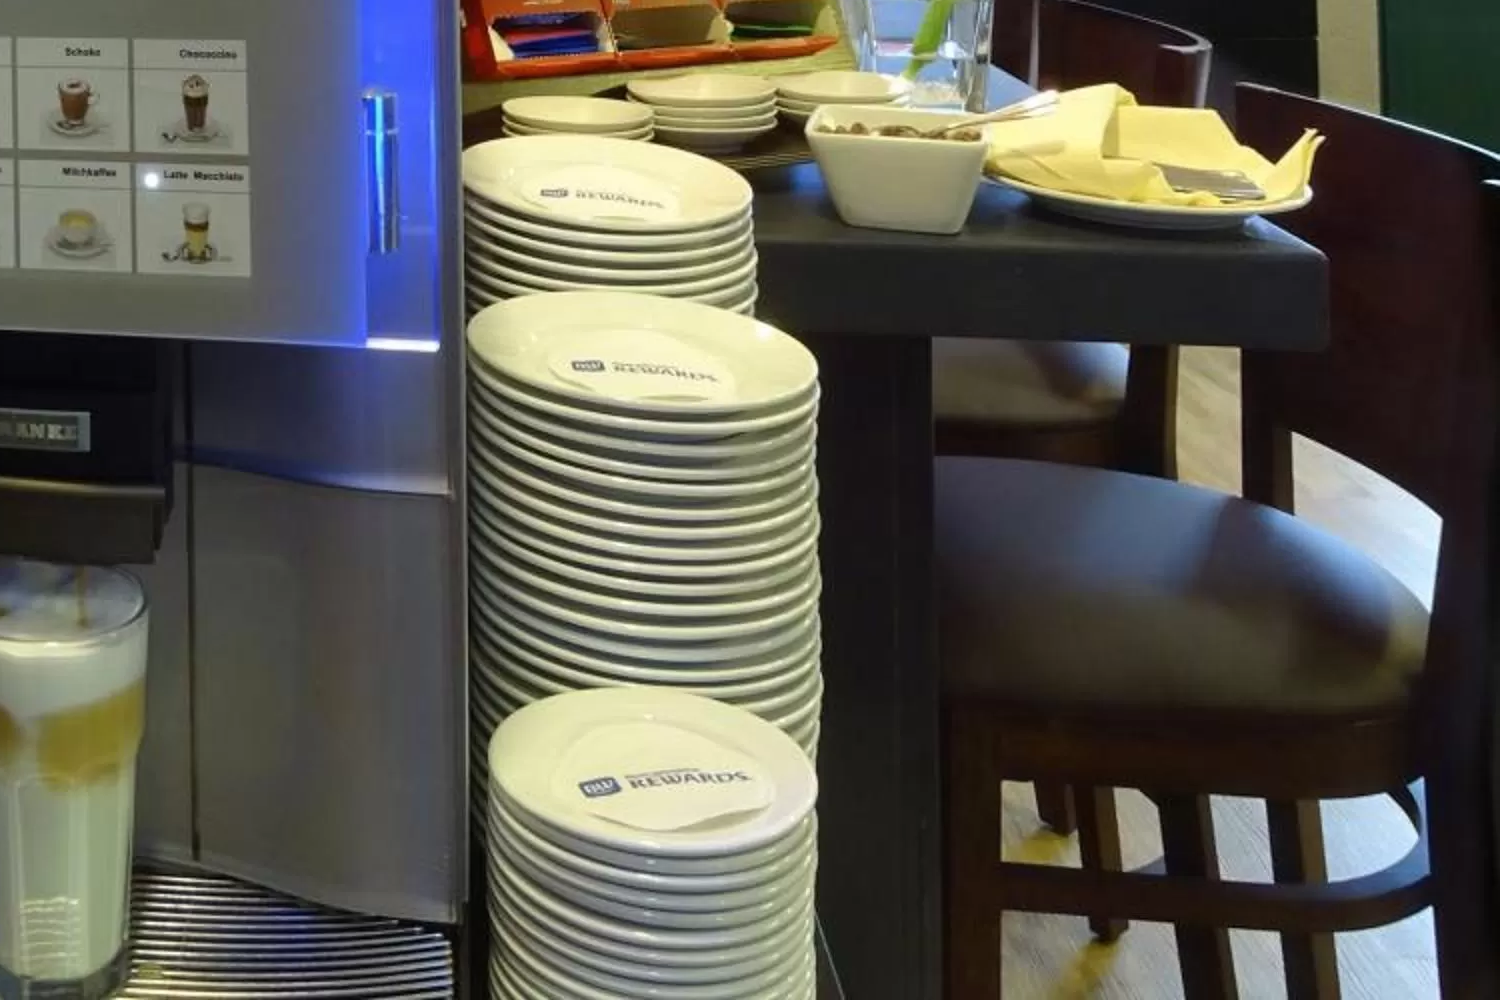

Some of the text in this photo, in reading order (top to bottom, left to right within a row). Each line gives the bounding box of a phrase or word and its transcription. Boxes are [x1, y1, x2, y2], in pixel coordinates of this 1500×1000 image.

[65, 47, 101, 57] Schoko
[62, 166, 117, 178] Milchkaffee
[163, 169, 245, 182] Latte Macchiato
[614, 362, 719, 384] REWARDS
[628, 771, 753, 790] REWARDS
